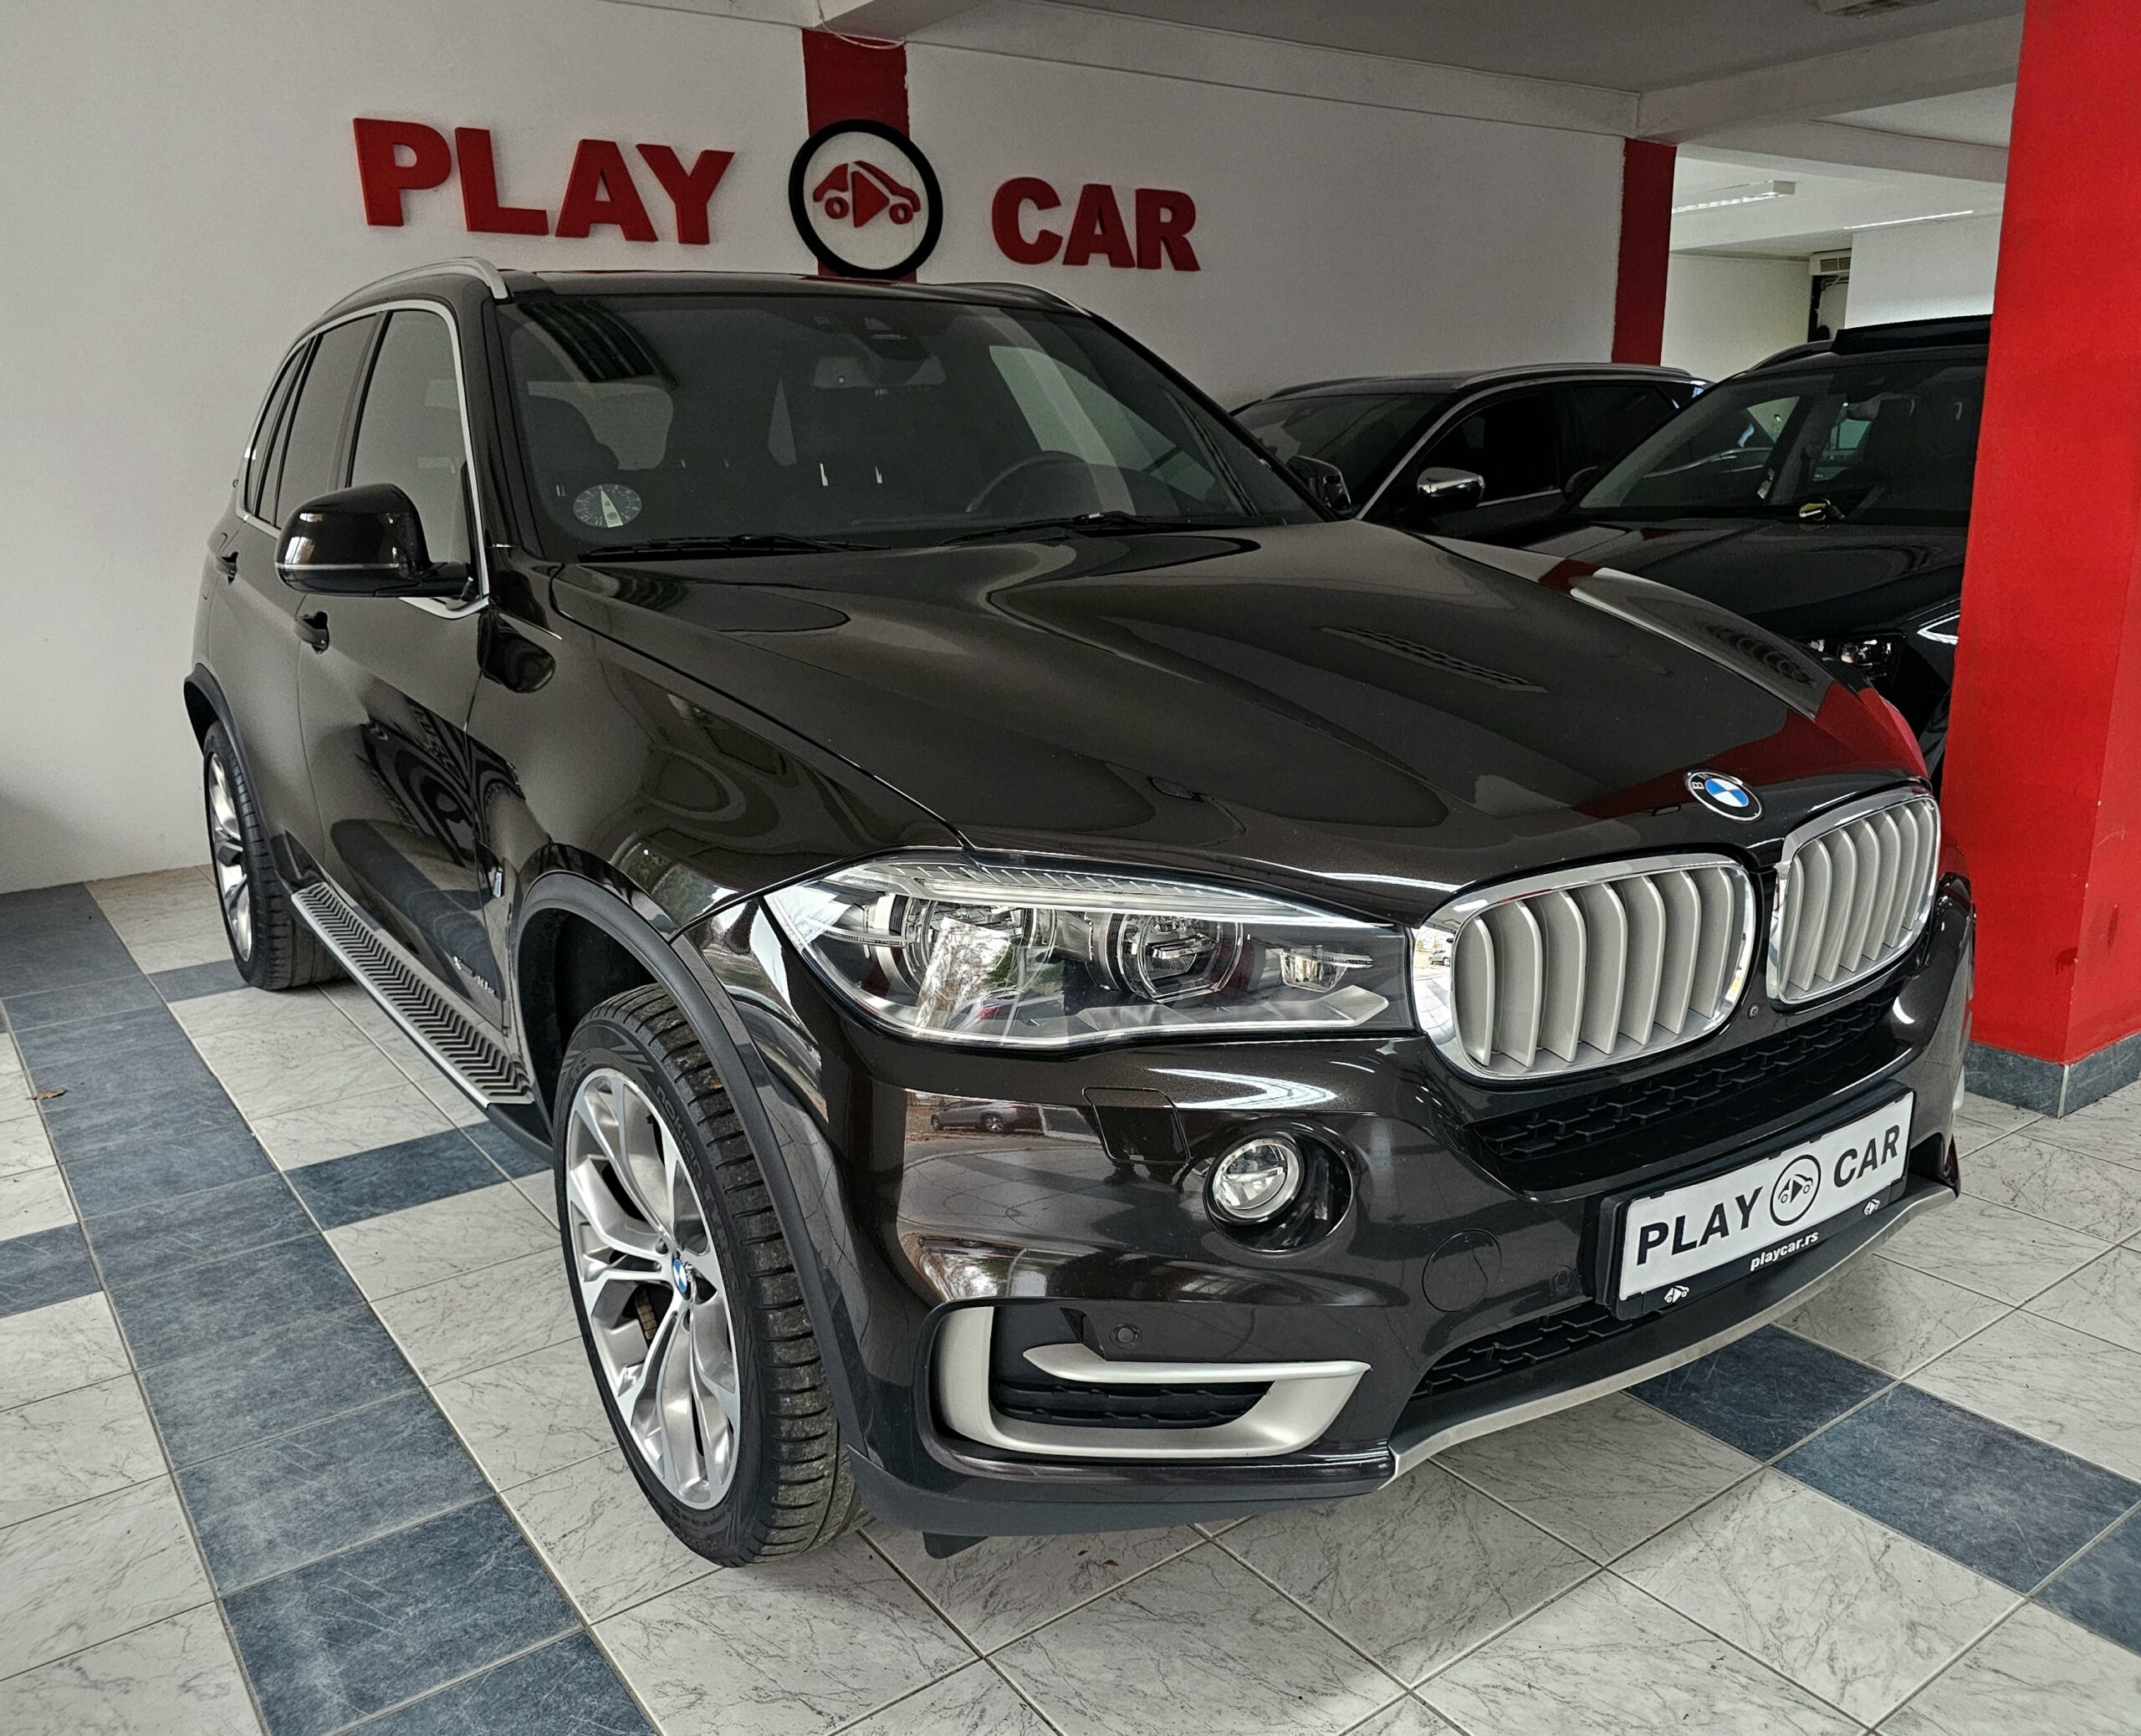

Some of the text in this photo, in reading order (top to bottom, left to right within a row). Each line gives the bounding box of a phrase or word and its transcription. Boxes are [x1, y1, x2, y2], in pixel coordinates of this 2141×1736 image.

[353, 117, 1201, 272] PLAY CAR
[1637, 1125, 1900, 1266] PLAY CAR
[1750, 1232, 1819, 1272] playcar.rs
